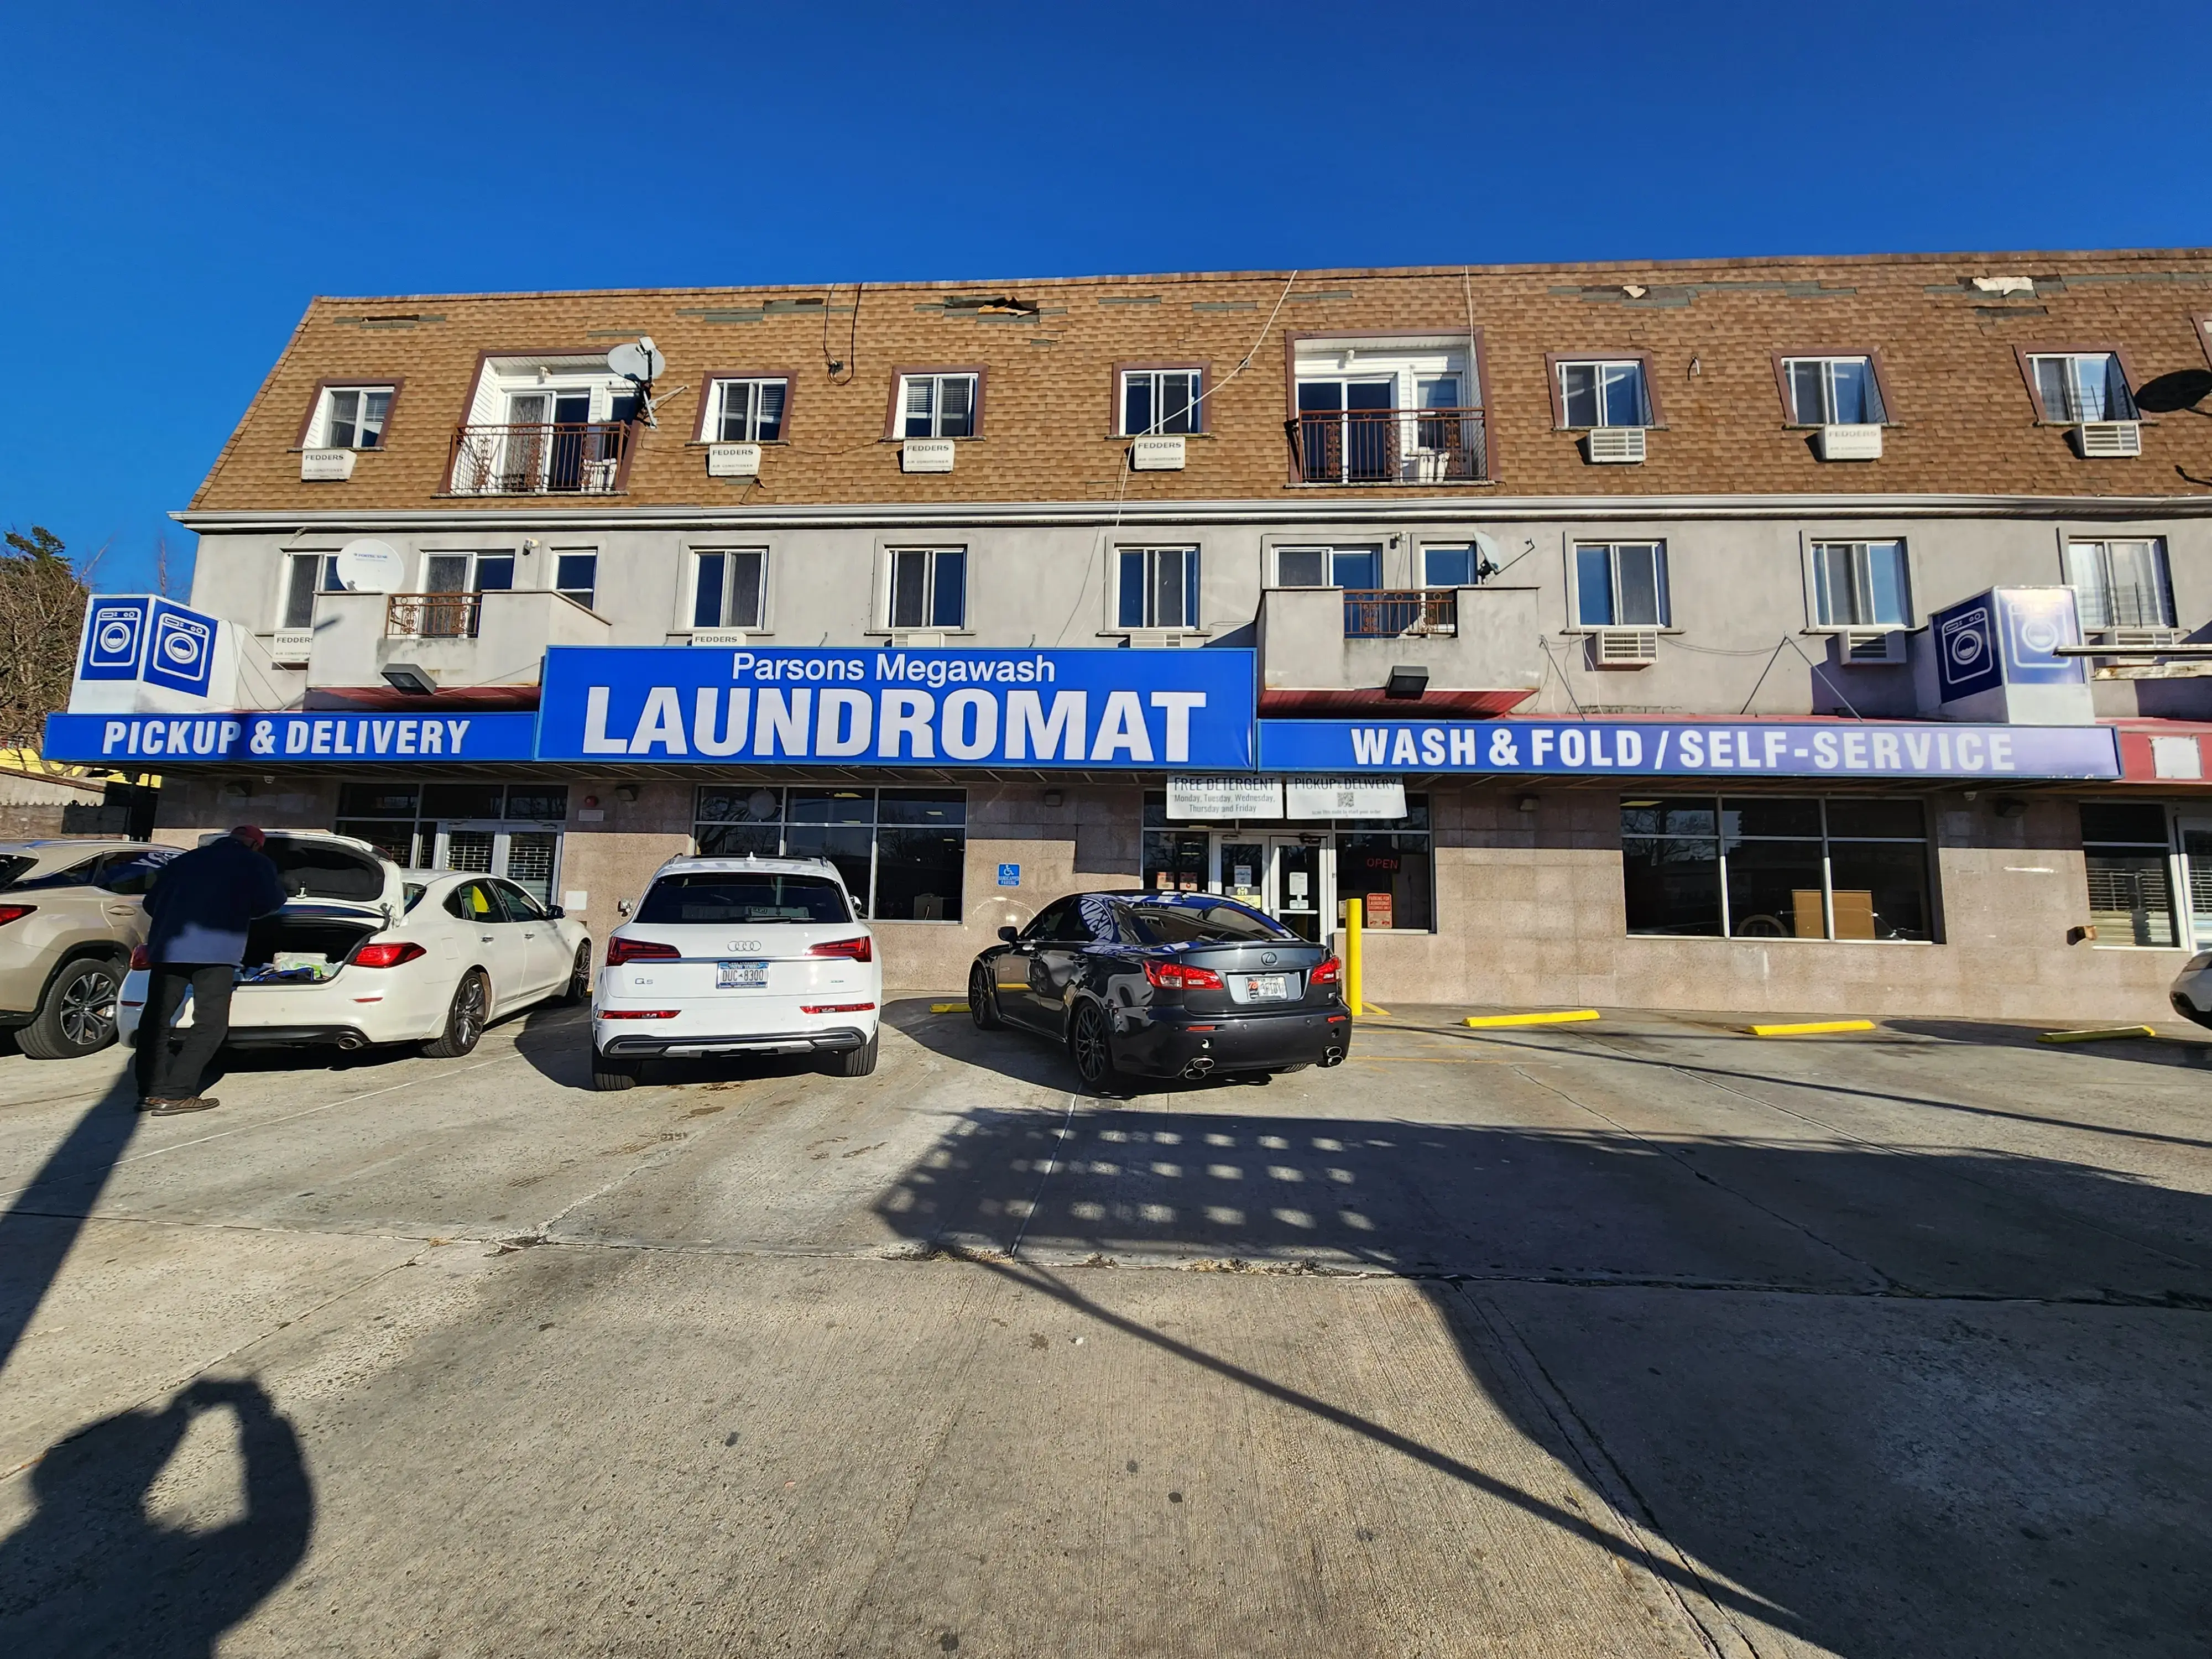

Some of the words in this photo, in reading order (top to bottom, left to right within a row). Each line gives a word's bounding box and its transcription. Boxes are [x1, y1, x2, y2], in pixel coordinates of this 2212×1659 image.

[733, 653, 864, 680] Parsons
[876, 653, 1055, 688] Megawash
[583, 687, 1207, 762] LAUNDROMAT
[102, 721, 241, 754] PICKUP
[250, 720, 275, 754] &
[285, 720, 470, 754] DELIVERY
[1351, 728, 1475, 765] WASH
[1489, 728, 1519, 766] &
[1532, 729, 1642, 766] FOLD
[1680, 731, 2016, 770] SELF-SERVICE
[1175, 778, 1202, 791] FREE
[1207, 778, 1275, 791] DETERGENT
[1295, 778, 1336, 789] PICKUP
[1345, 778, 1396, 790] DELIVERY
[1204, 794, 1233, 802] Tuesday,
[1235, 794, 1275, 802] Wednesday,
[1190, 805, 1219, 813] Thursday
[1367, 858, 1398, 869] OPEN
